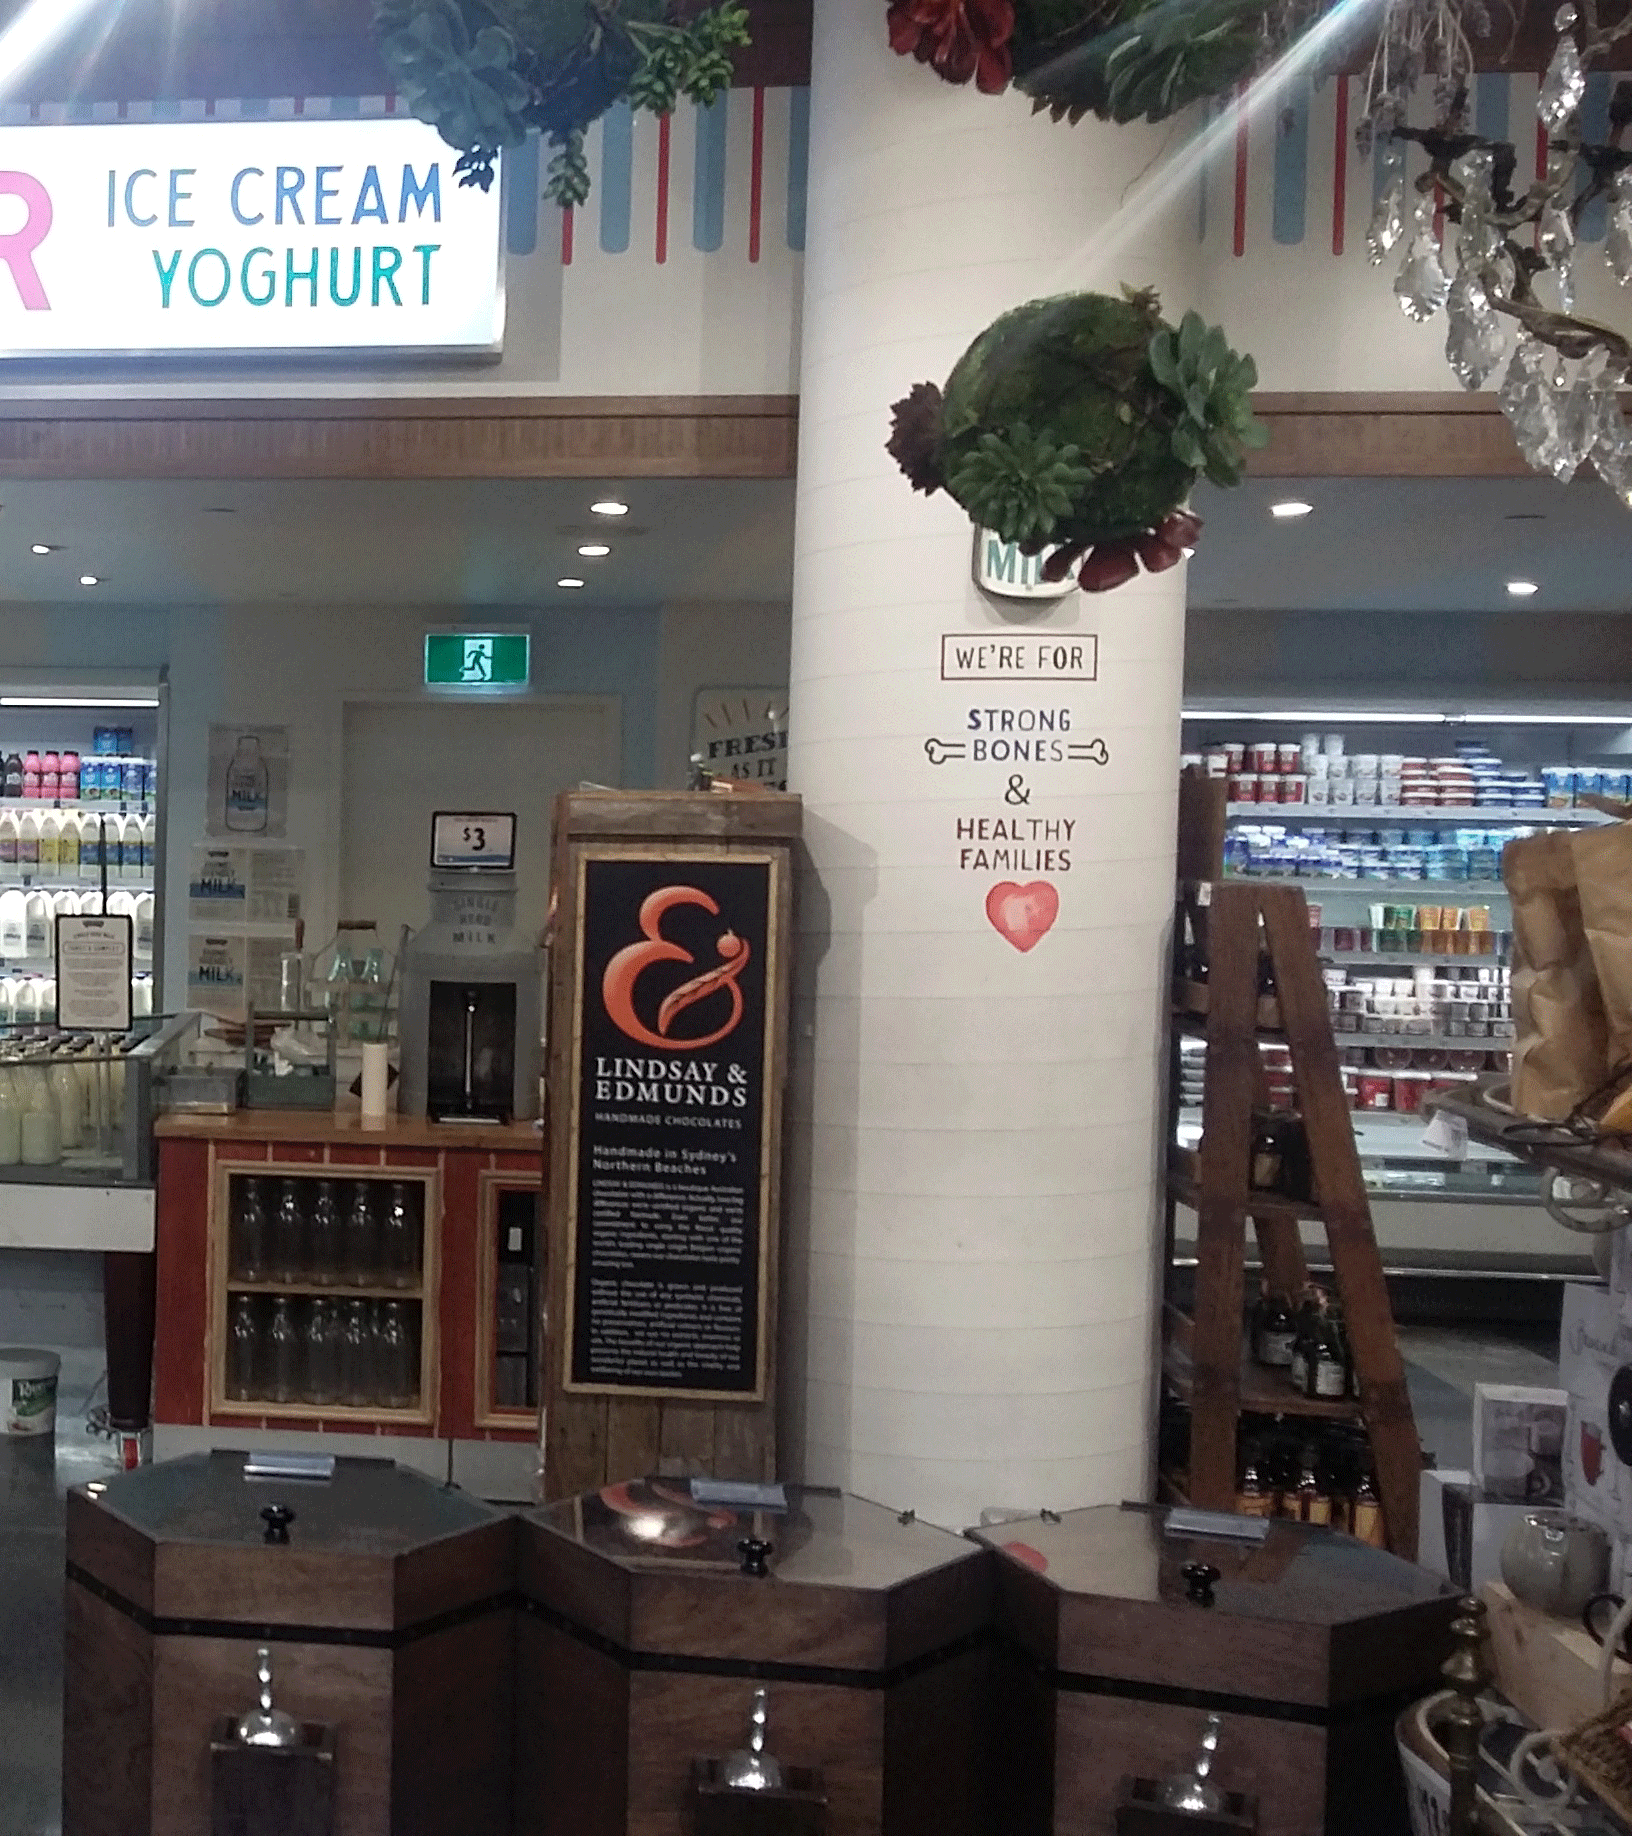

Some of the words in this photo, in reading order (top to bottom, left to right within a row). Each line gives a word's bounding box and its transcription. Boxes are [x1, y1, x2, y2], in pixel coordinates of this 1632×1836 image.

[107, 168, 196, 229] ICE
[229, 164, 444, 227] CREAM
[151, 243, 443, 311] YOGHURT
[955, 643, 1026, 671] WE'RE
[1038, 645, 1084, 671] FOR
[967, 708, 1072, 733] STRONG
[972, 738, 1064, 763] BONES
[757, 757, 777, 778] IT
[1004, 773, 1031, 806] &
[462, 827, 486, 851] $3
[955, 818, 1077, 842] HEALTHY
[959, 848, 1072, 872] FAMILIES
[595, 1056, 718, 1083] LINDSAY
[726, 1062, 748, 1085] &
[594, 1079, 748, 1108] EDMUNDS
[594, 1111, 662, 1127] HANDMADE
[664, 1115, 743, 1131] CHOCOLATES
[592, 1144, 662, 1159] Handmade
[664, 1149, 678, 1160] in
[680, 1149, 737, 1164] Sydney's
[592, 1158, 652, 1173] Northern
[653, 1161, 707, 1176] Beaches
